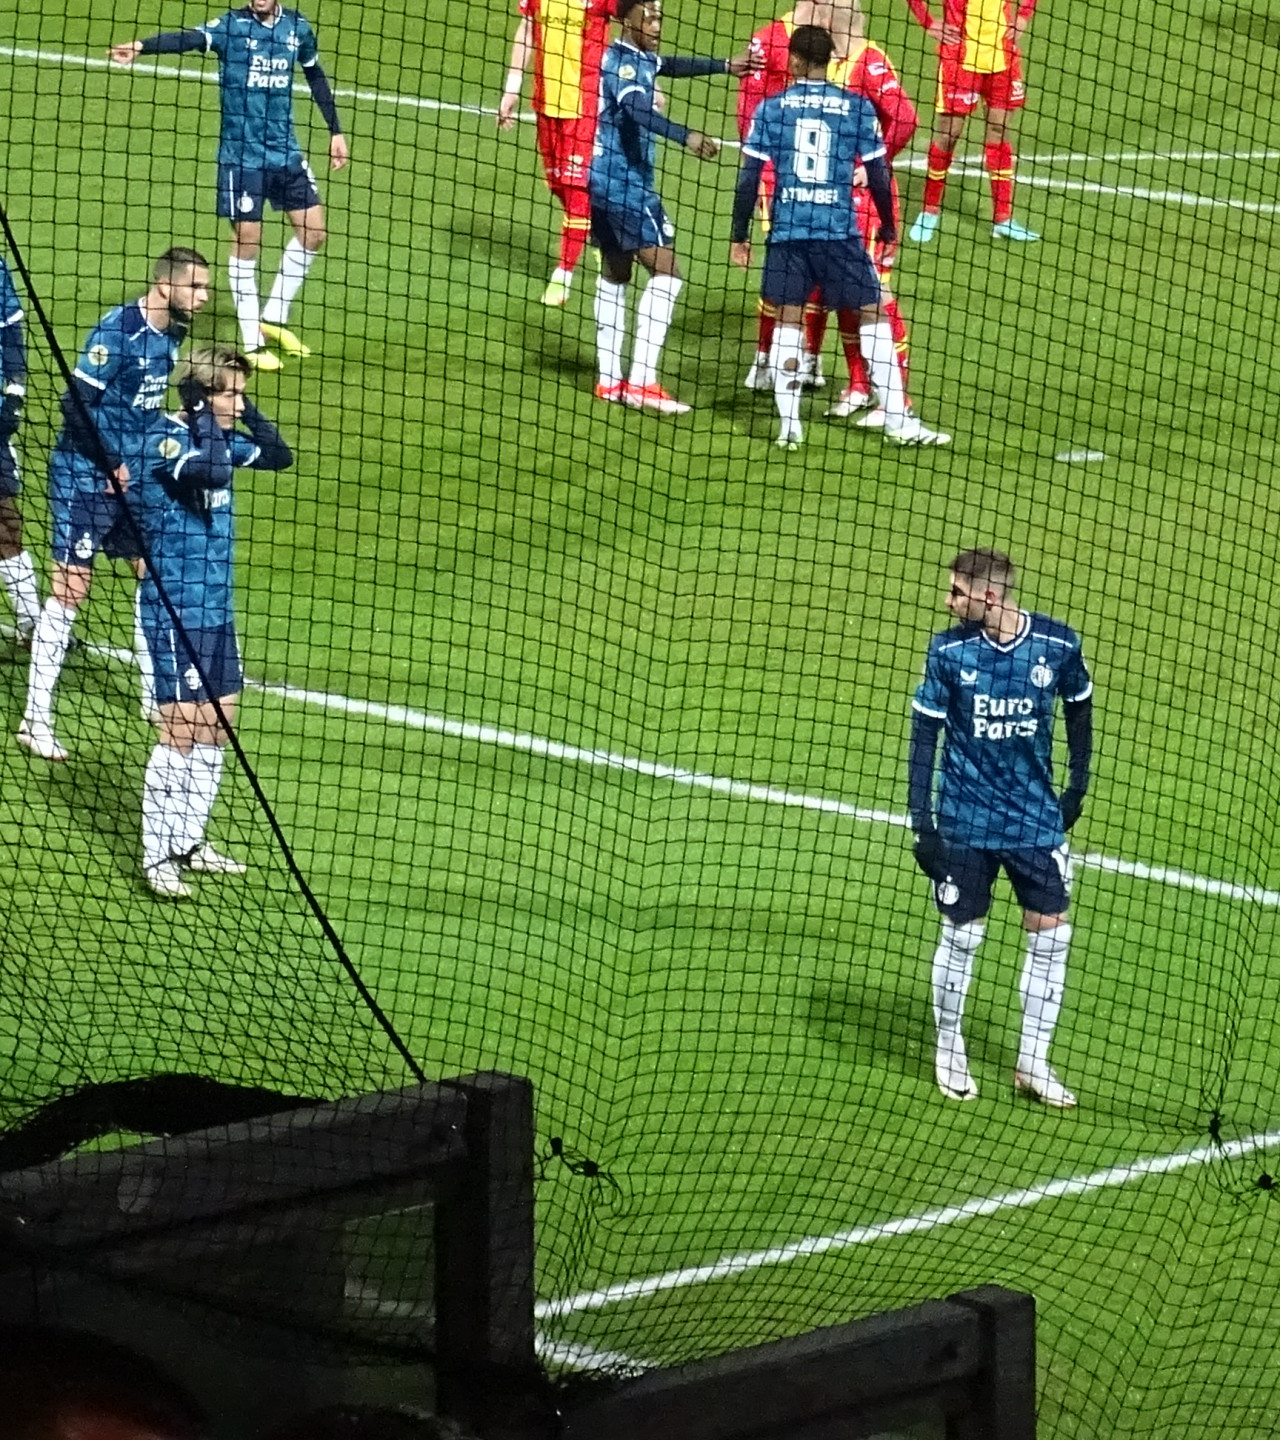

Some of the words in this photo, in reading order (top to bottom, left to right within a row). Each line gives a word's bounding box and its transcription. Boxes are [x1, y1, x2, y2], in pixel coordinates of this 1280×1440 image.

[250, 54, 288, 71] Euro
[247, 71, 289, 88] Parcs
[793, 118, 831, 184] 8
[973, 694, 1033, 717] Euro
[973, 718, 1038, 740] Parcs
